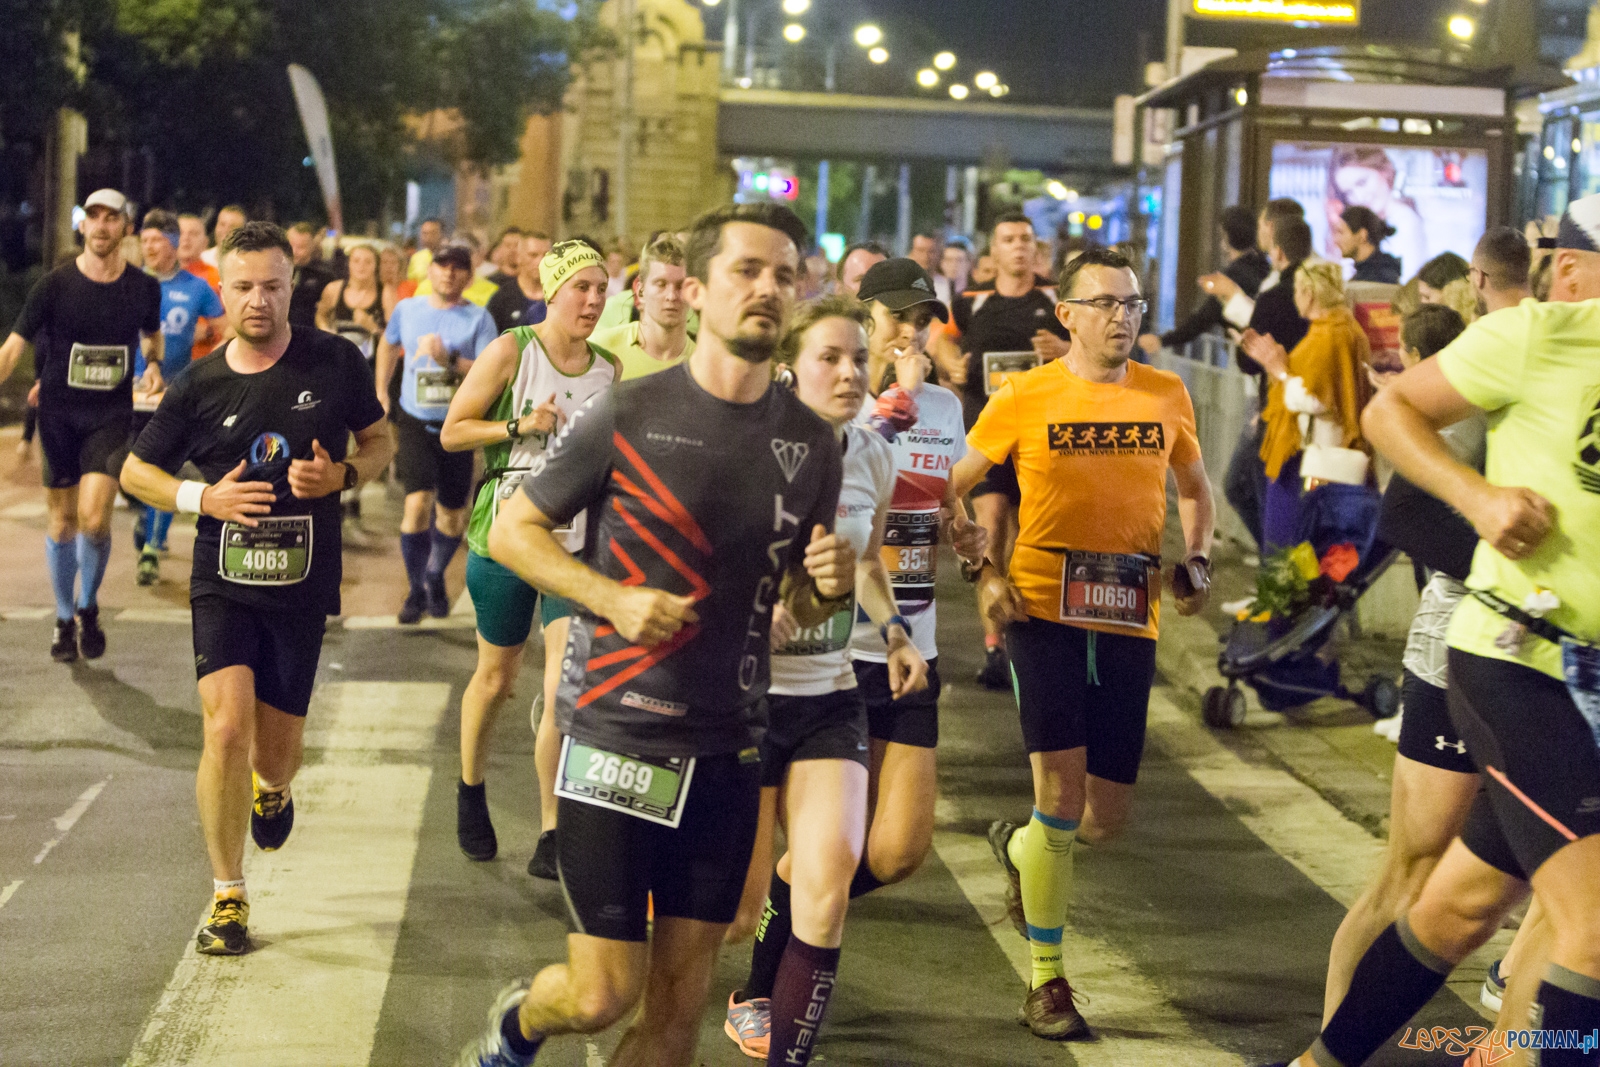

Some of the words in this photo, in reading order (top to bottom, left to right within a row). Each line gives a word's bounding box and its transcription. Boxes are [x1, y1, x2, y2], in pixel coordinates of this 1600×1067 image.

[553, 265, 566, 281] LG
[567, 253, 603, 268] MAUE
[85, 365, 112, 381] 1230
[1089, 449, 1116, 457] NEVER
[1136, 449, 1160, 457] ALONE
[242, 550, 288, 570] 4063
[1083, 584, 1137, 609] 10650
[585, 752, 653, 794] 2669
[786, 969, 835, 1065] kalenji
